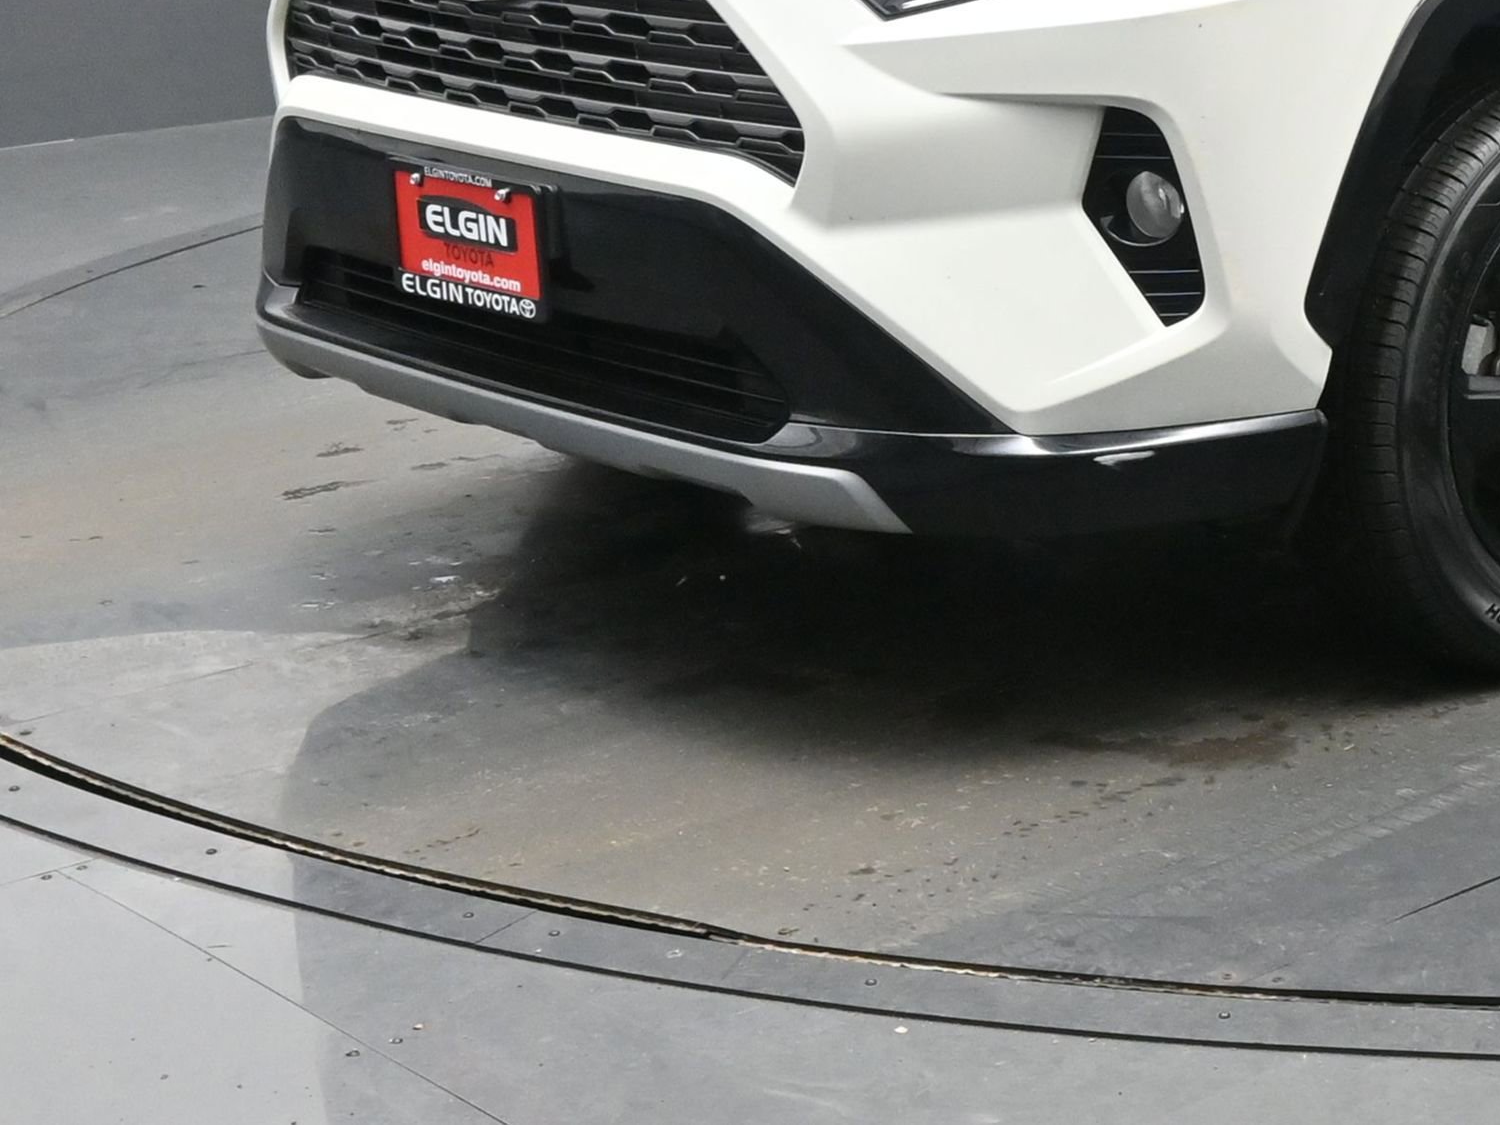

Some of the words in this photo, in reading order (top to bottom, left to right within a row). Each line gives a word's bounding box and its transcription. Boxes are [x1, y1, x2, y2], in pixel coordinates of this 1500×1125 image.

[424, 166, 492, 188] ELGINTOYOTA.COM
[425, 204, 509, 247] ELGIN
[445, 243, 495, 267] TOYOTA
[421, 258, 521, 293] elgintoyota.com
[401, 273, 464, 304] ELGIN
[465, 287, 520, 316] TOYOTA
